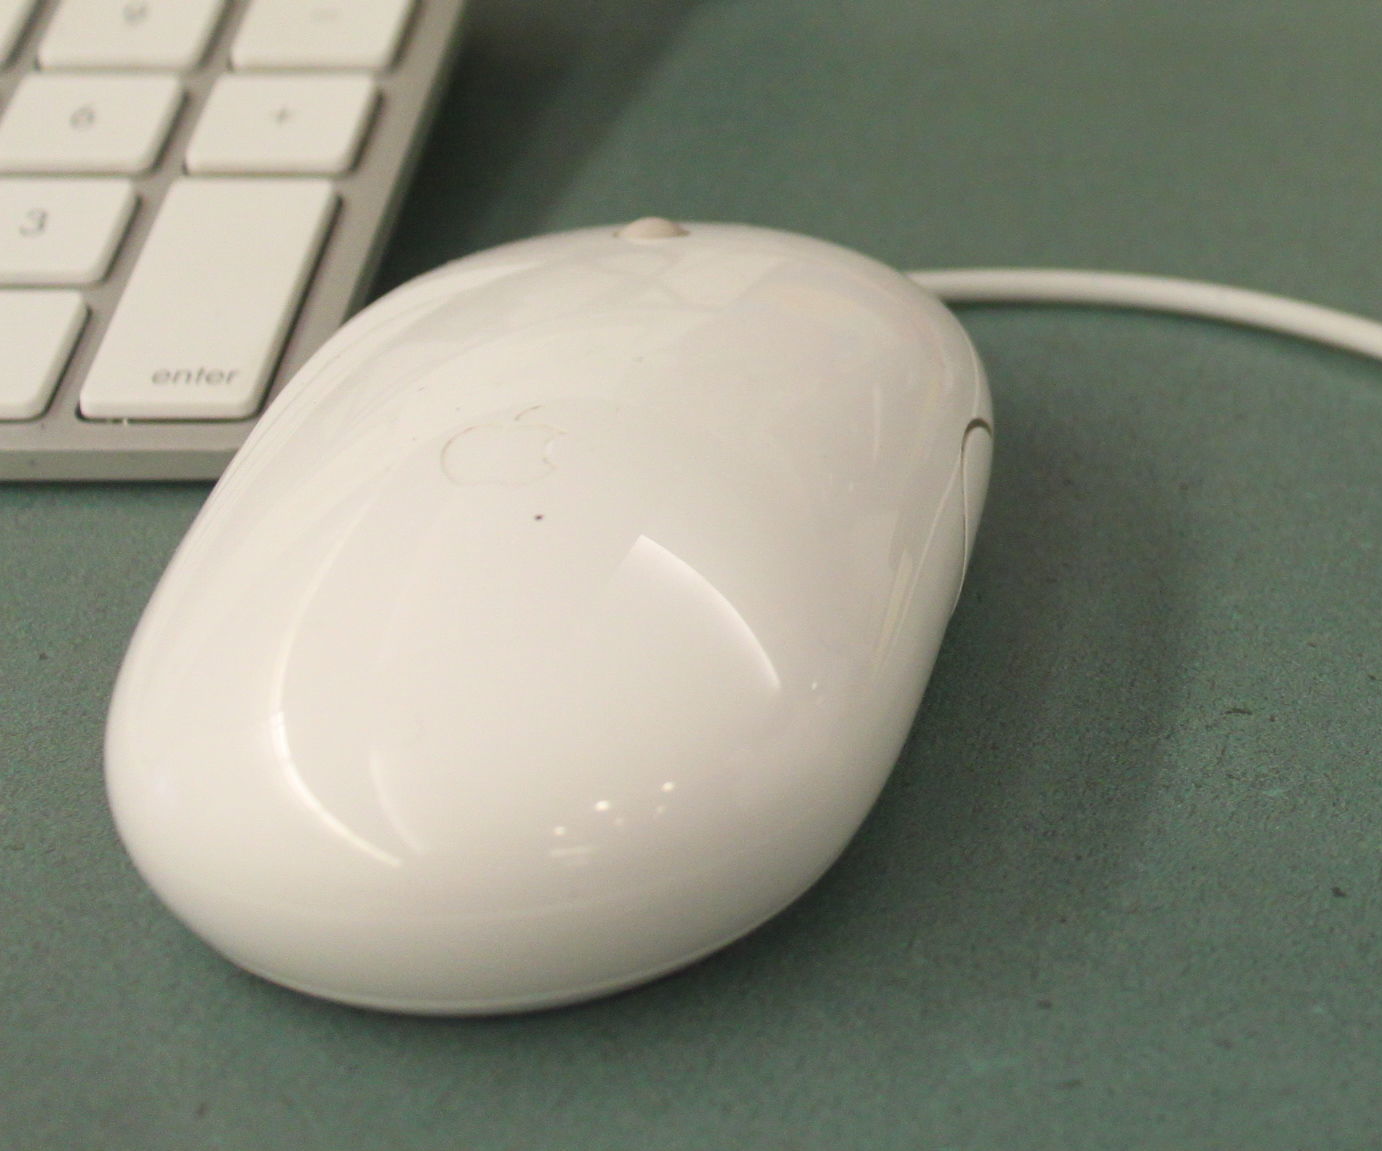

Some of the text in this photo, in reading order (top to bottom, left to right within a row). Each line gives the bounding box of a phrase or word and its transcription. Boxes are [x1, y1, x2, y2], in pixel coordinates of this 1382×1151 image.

[69, 106, 96, 131] 6
[18, 208, 48, 238] 3
[151, 366, 240, 386] enter
